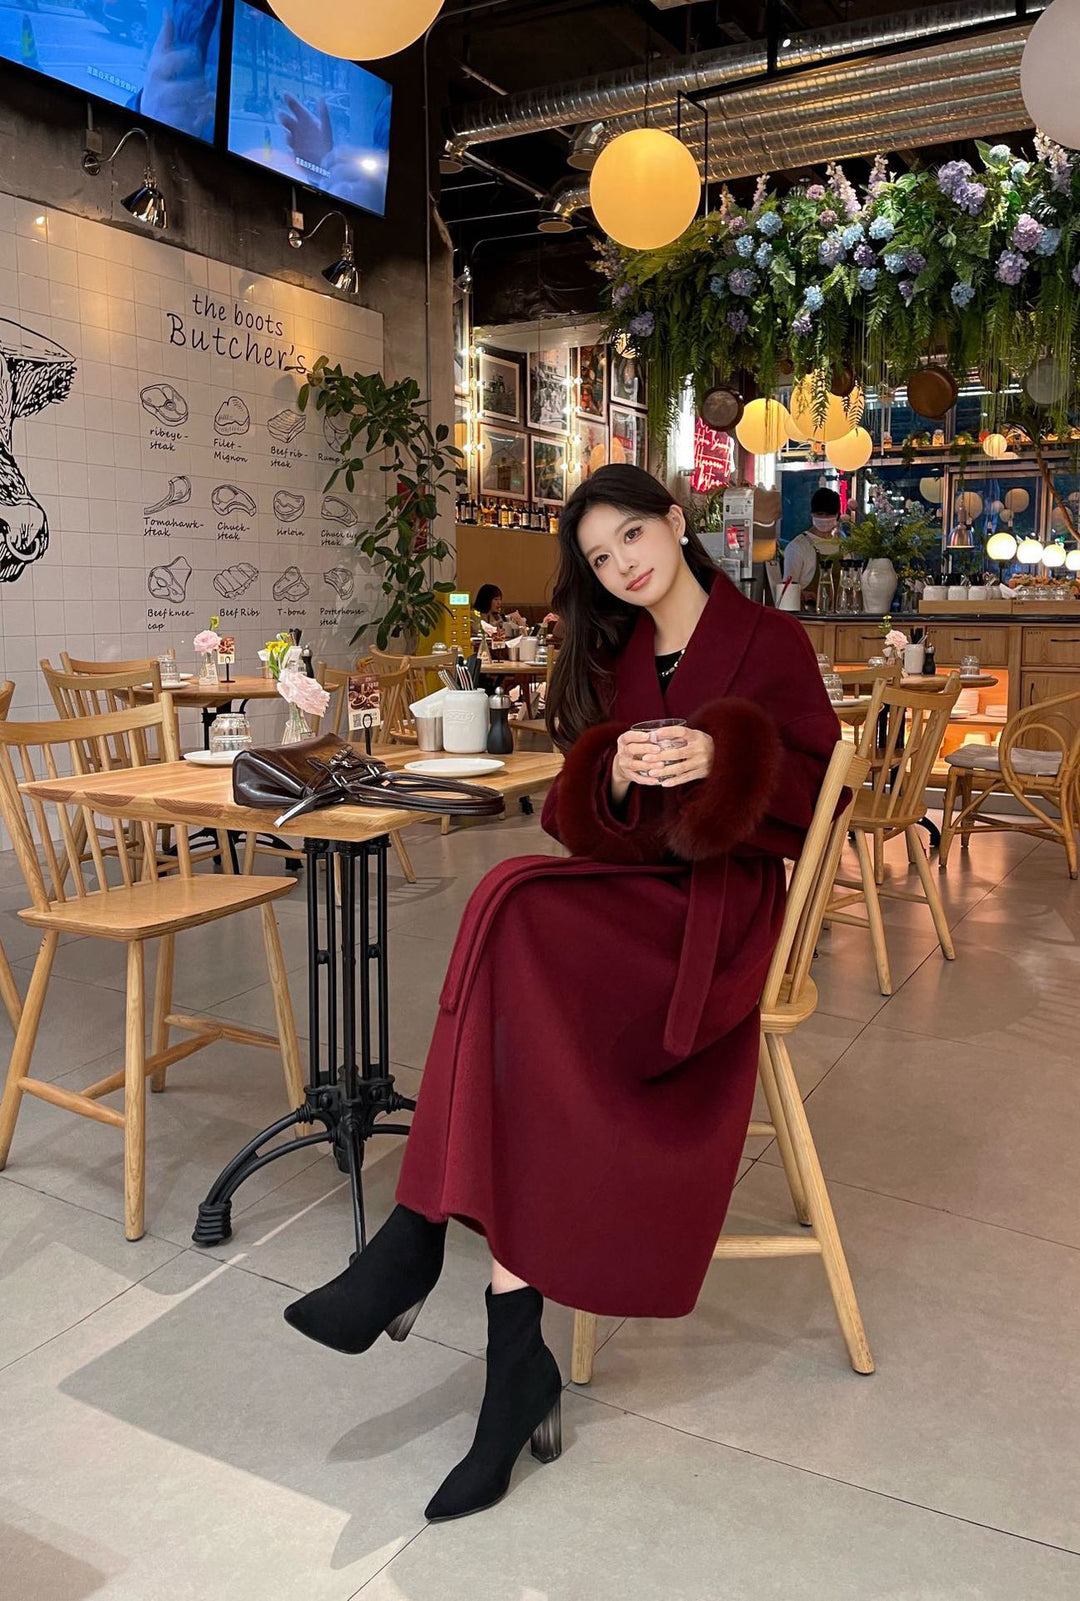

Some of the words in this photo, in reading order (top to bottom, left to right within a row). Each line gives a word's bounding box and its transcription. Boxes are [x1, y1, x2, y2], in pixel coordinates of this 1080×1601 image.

[192, 294, 227, 321] the
[234, 303, 283, 336] boots
[167, 312, 307, 374] Butcher's
[149, 440, 176, 452] steak
[213, 451, 248, 463] Mignon
[270, 446, 288, 459] Beef
[270, 459, 292, 469] steak
[143, 526, 171, 537] steak
[217, 532, 240, 541] steak
[320, 538, 342, 547] steak
[147, 608, 168, 619] Beef
[219, 608, 241, 618] Beef
[240, 608, 261, 617] Ribs
[277, 608, 307, 616] T-bone
[147, 622, 165, 632] cap
